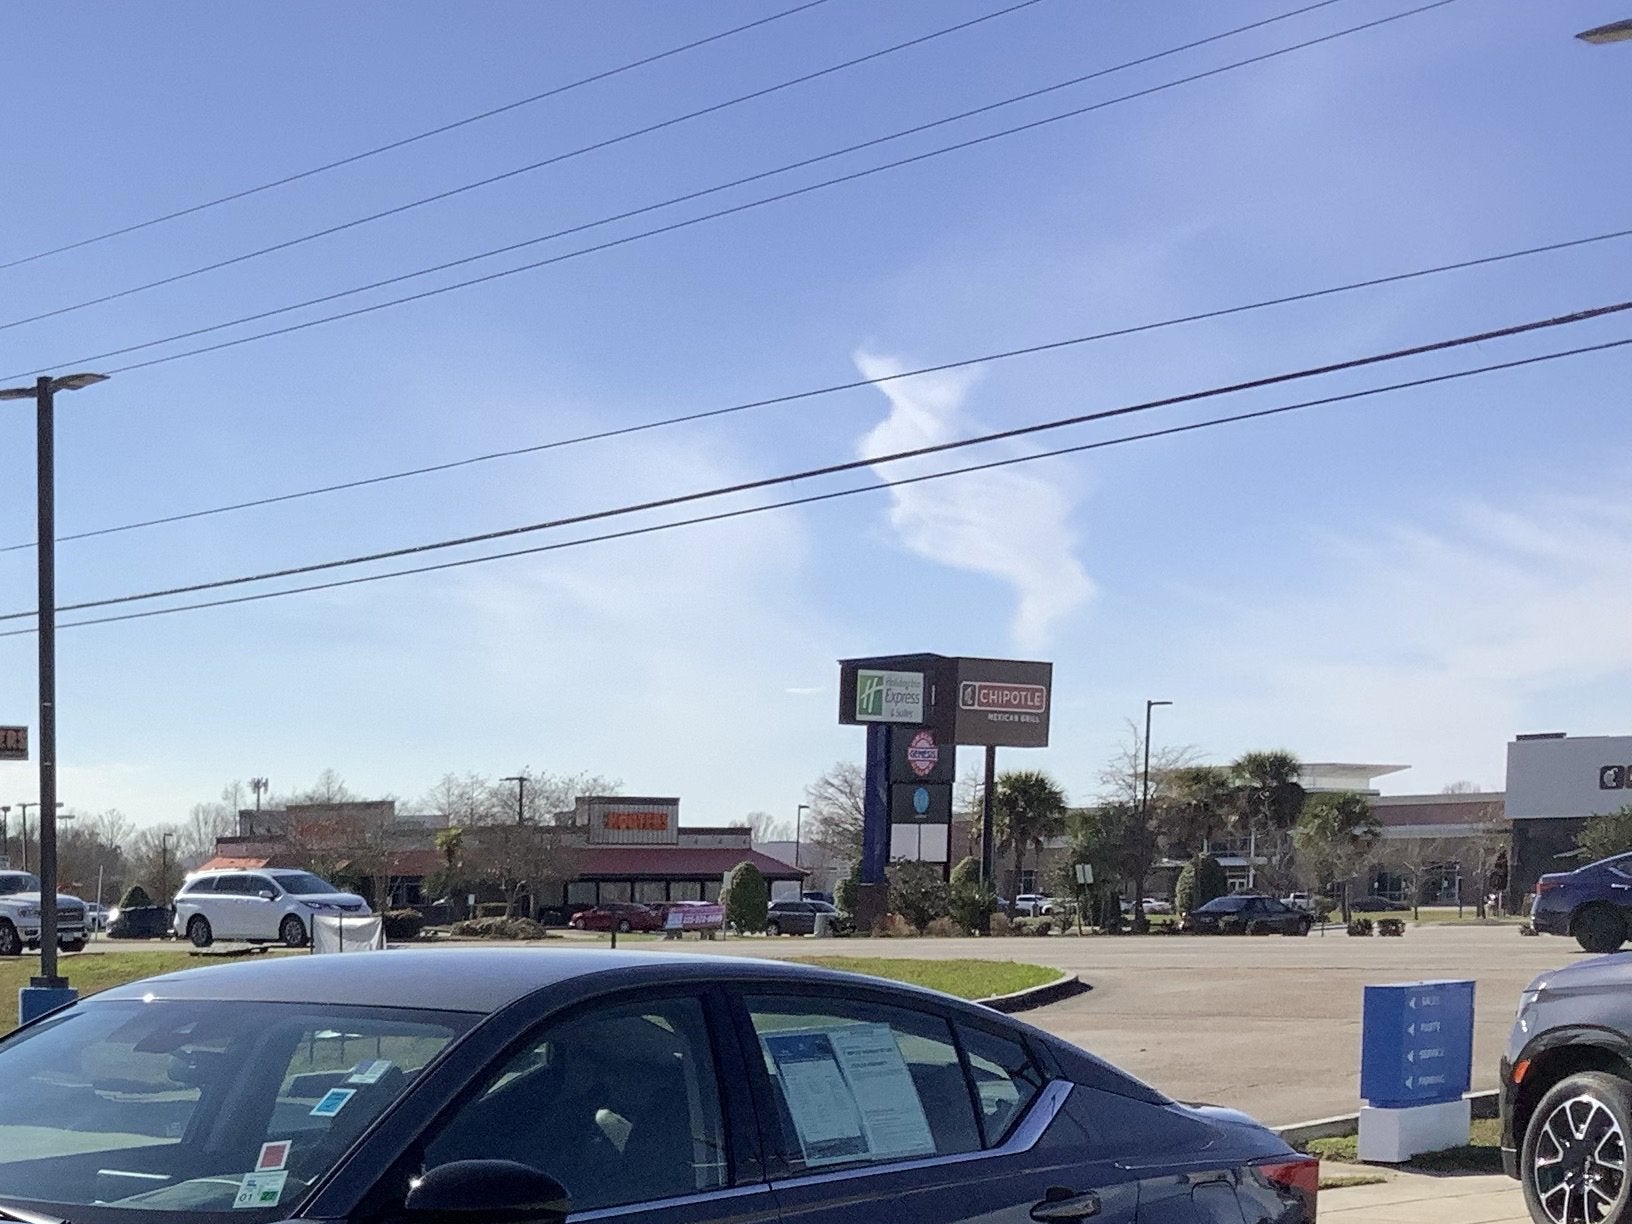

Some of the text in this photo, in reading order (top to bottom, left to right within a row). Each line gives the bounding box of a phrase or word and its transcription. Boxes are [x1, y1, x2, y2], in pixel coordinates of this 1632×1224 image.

[885, 688, 920, 706] Express
[979, 689, 1042, 706] CHIPOTLE
[239, 1193, 253, 1202] 01
